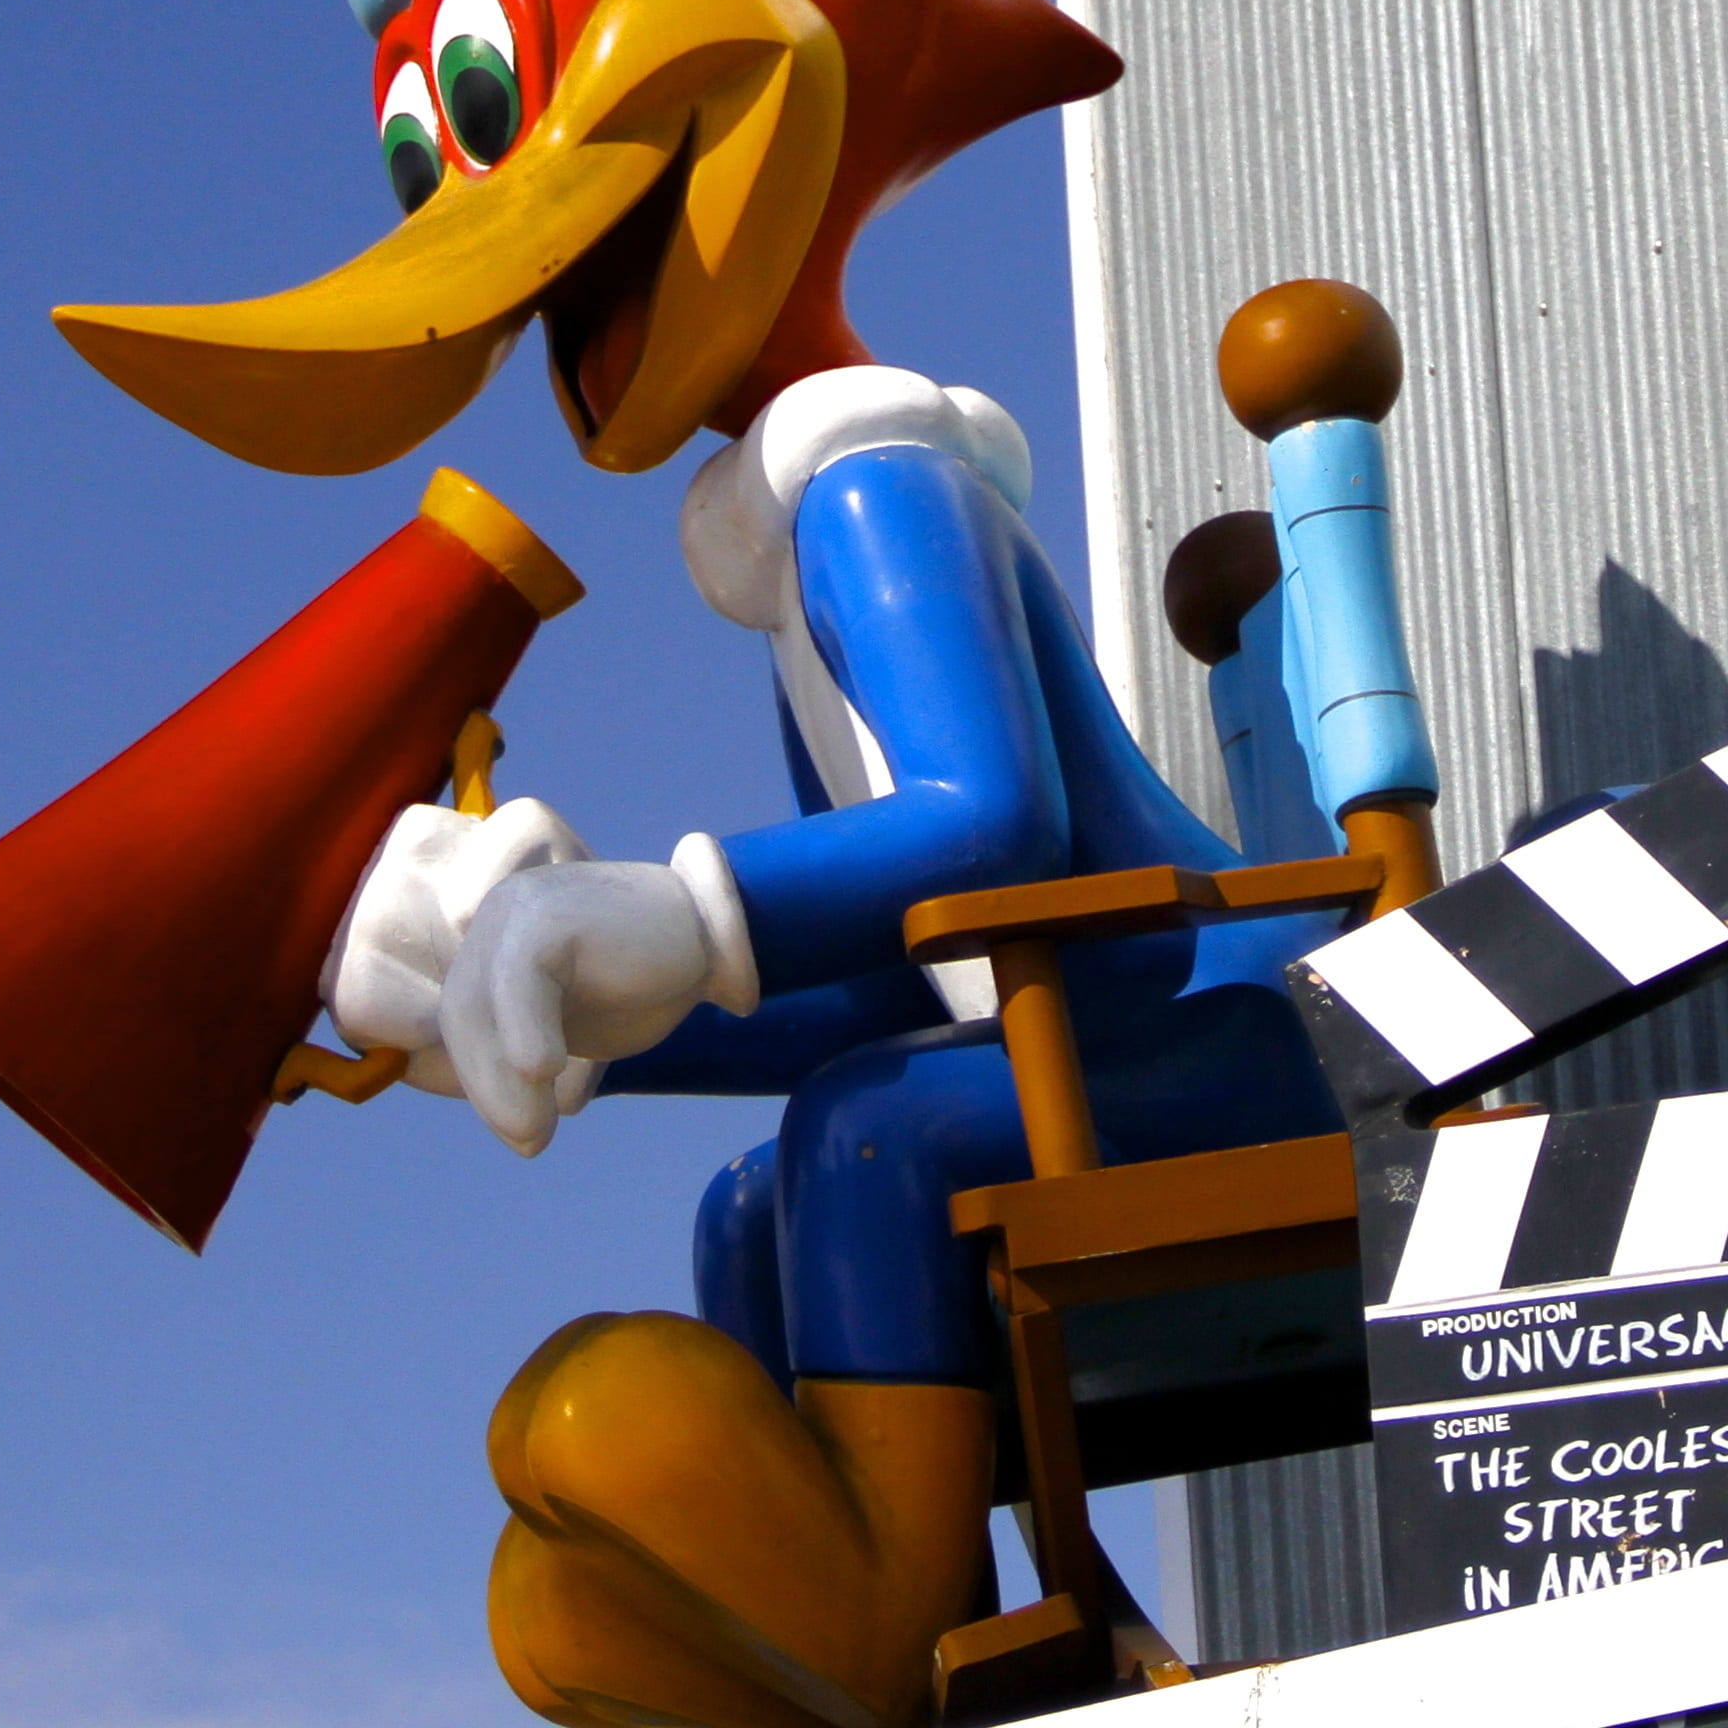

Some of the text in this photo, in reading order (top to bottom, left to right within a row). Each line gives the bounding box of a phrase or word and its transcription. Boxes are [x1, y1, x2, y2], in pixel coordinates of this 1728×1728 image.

[1422, 1302, 1577, 1337] PRODUCTION
[1434, 1413, 1510, 1439] SCENE
[1435, 1446, 1530, 1492] THE
[1504, 1490, 1690, 1543] STREET
